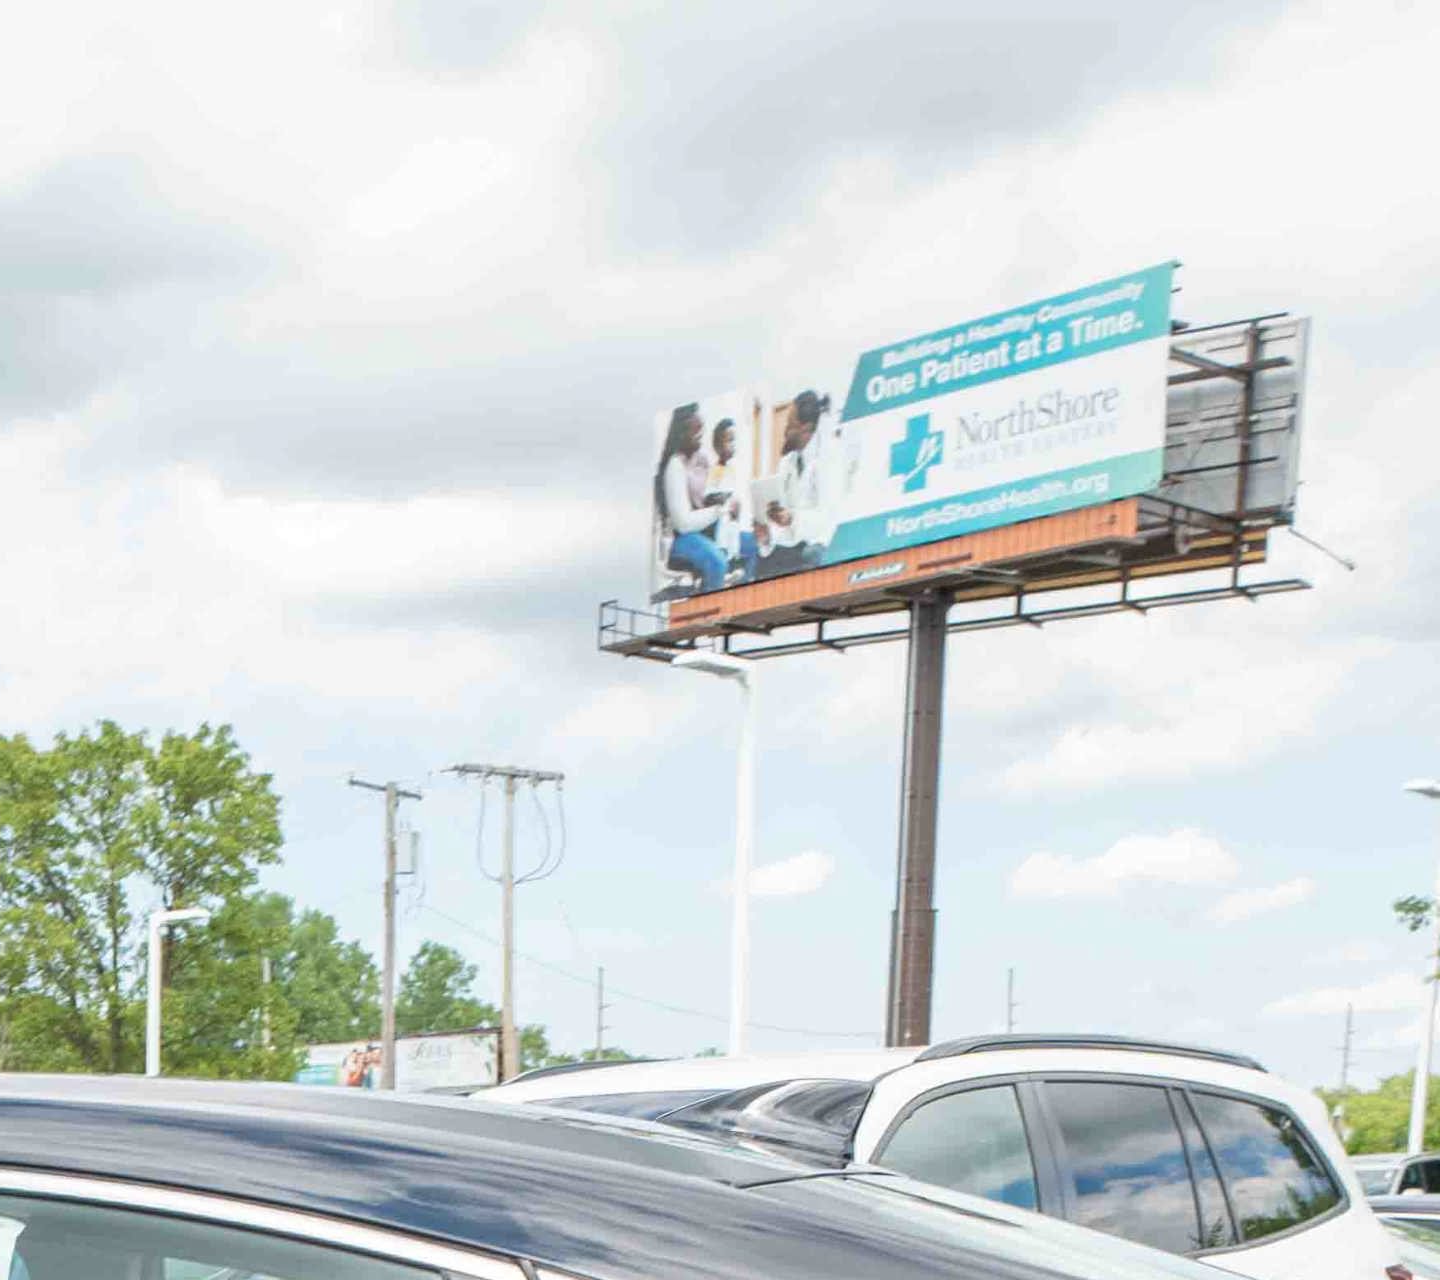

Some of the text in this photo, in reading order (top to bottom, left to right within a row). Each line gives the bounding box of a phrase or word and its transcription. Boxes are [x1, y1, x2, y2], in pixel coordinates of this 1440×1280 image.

[867, 309, 1144, 402] One Patient at a Time.
[956, 386, 1119, 449] NorthShore
